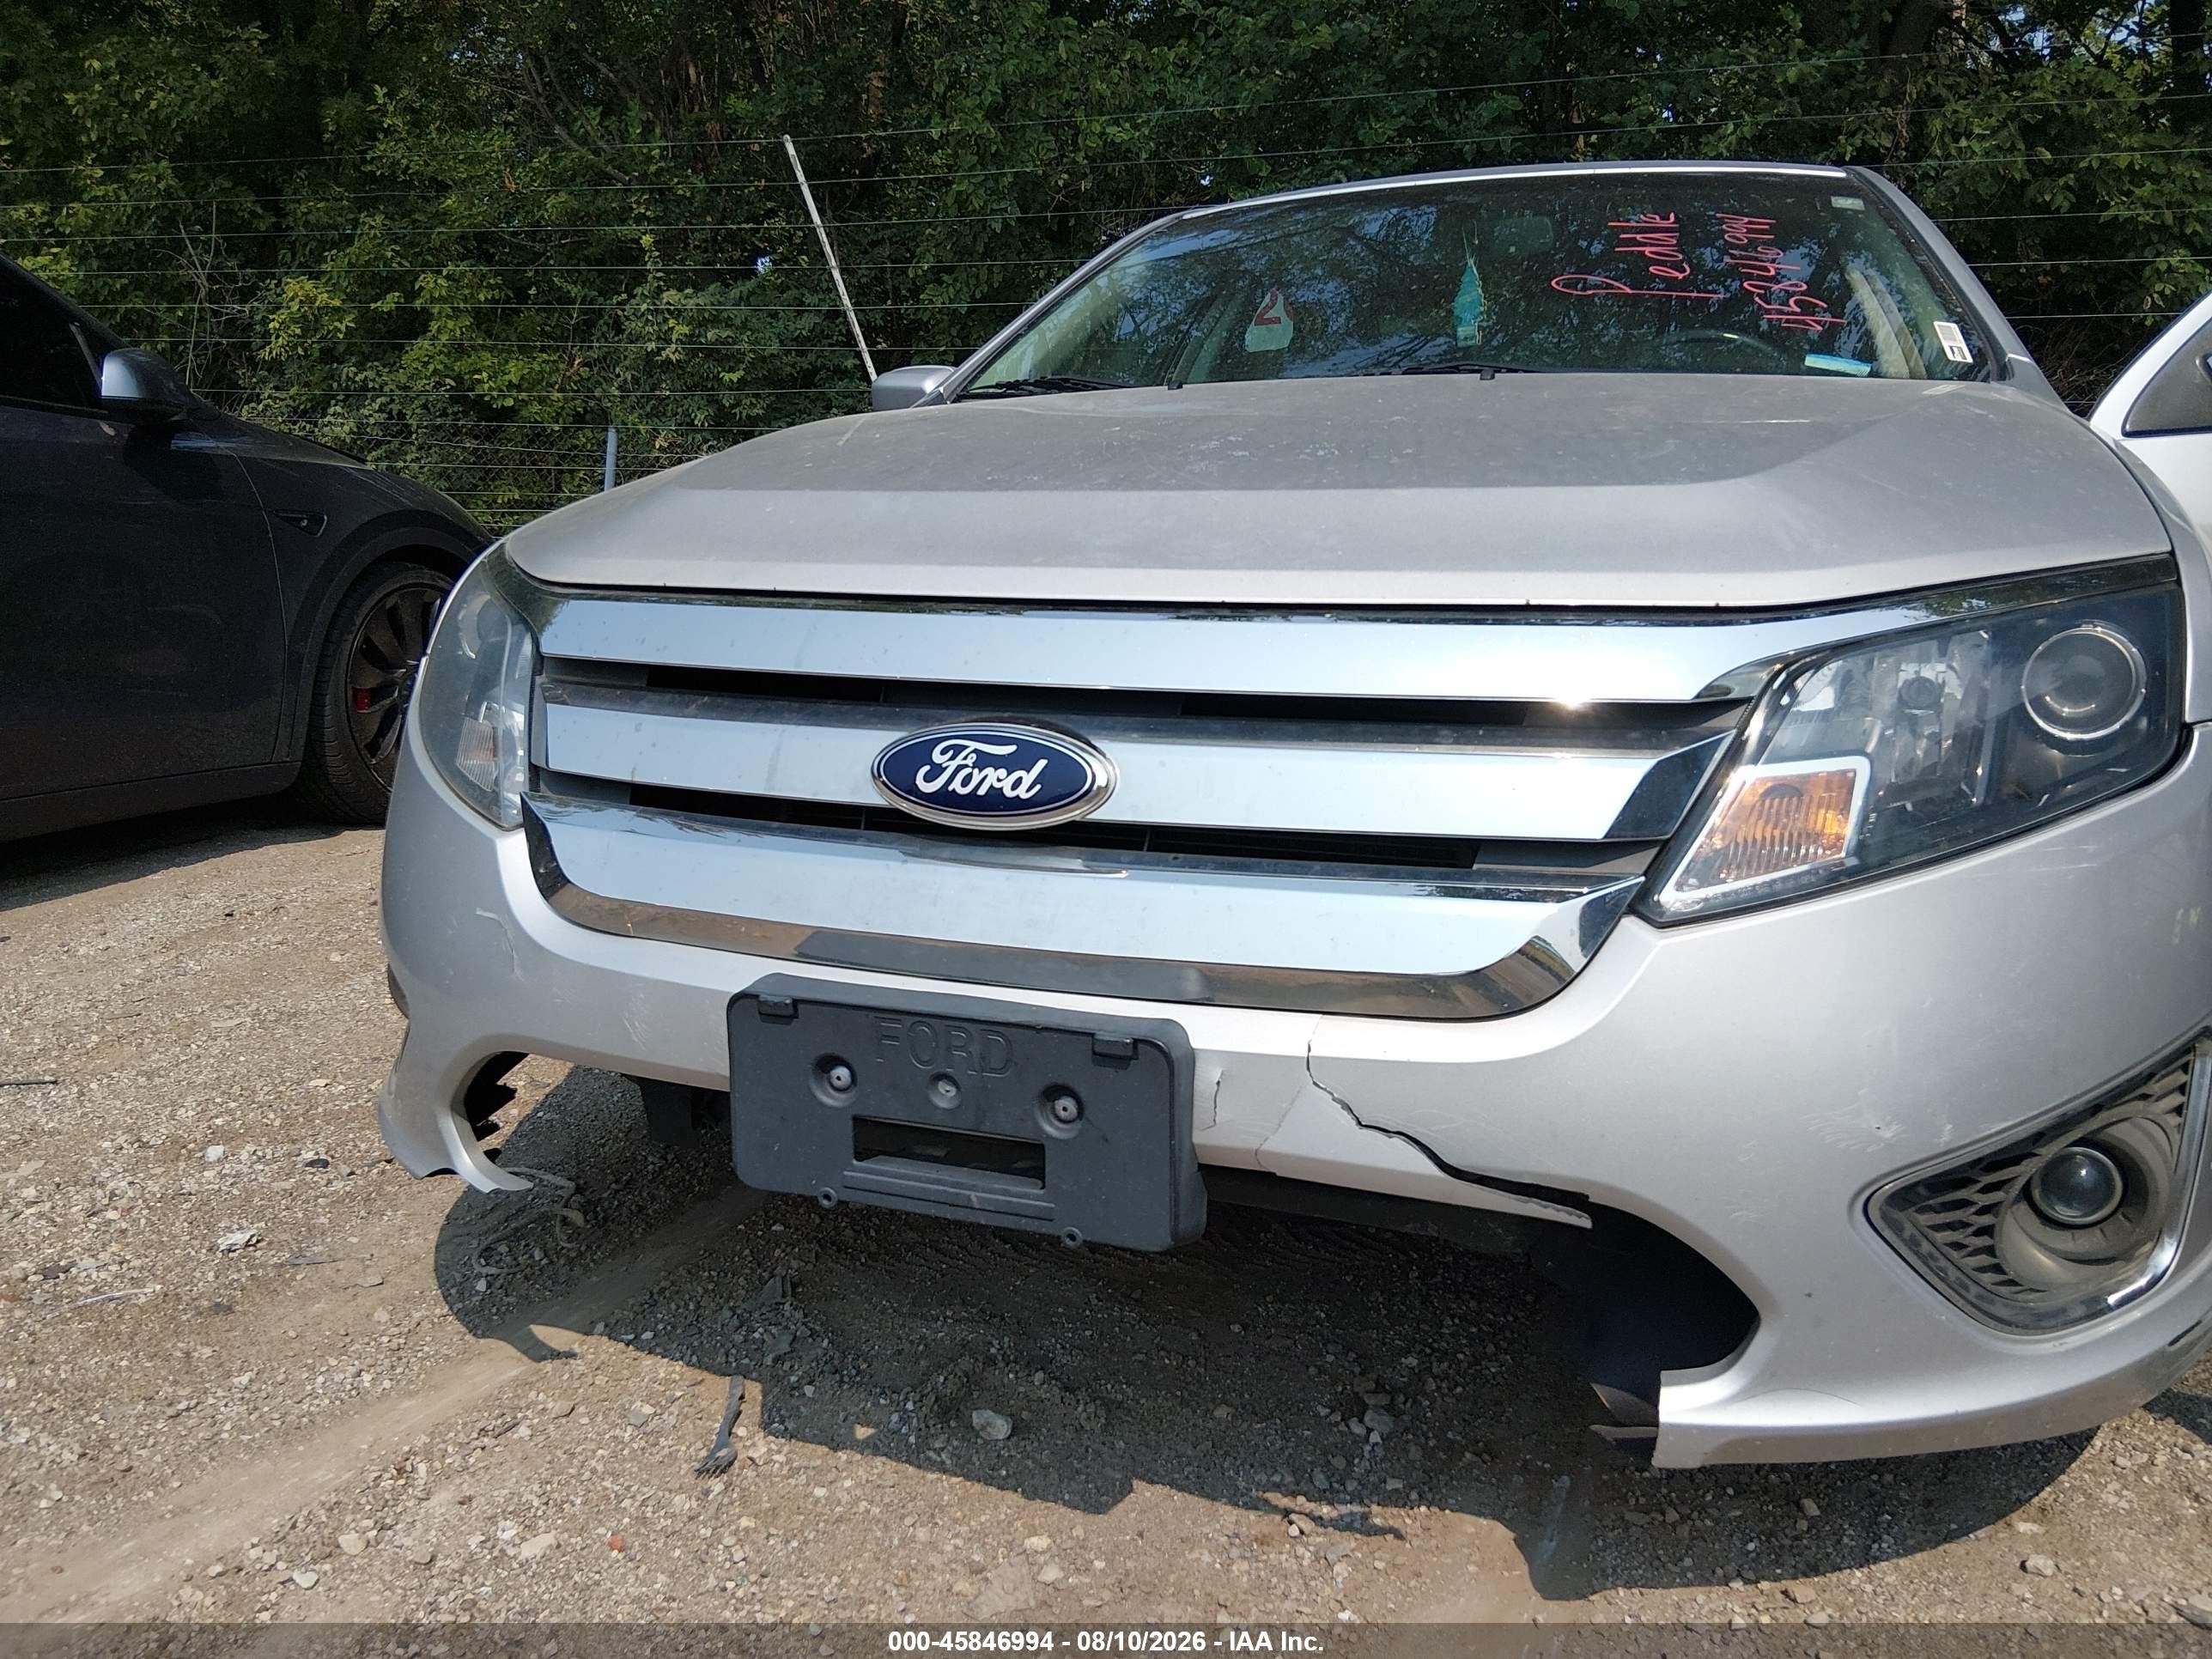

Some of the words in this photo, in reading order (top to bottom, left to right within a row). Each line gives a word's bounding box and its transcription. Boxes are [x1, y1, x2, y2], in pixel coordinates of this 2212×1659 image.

[1551, 212, 1726, 298] Peddle
[1717, 213, 1847, 331] 45846994
[915, 739, 1048, 799] Ford
[875, 1018, 1013, 1077] FORD
